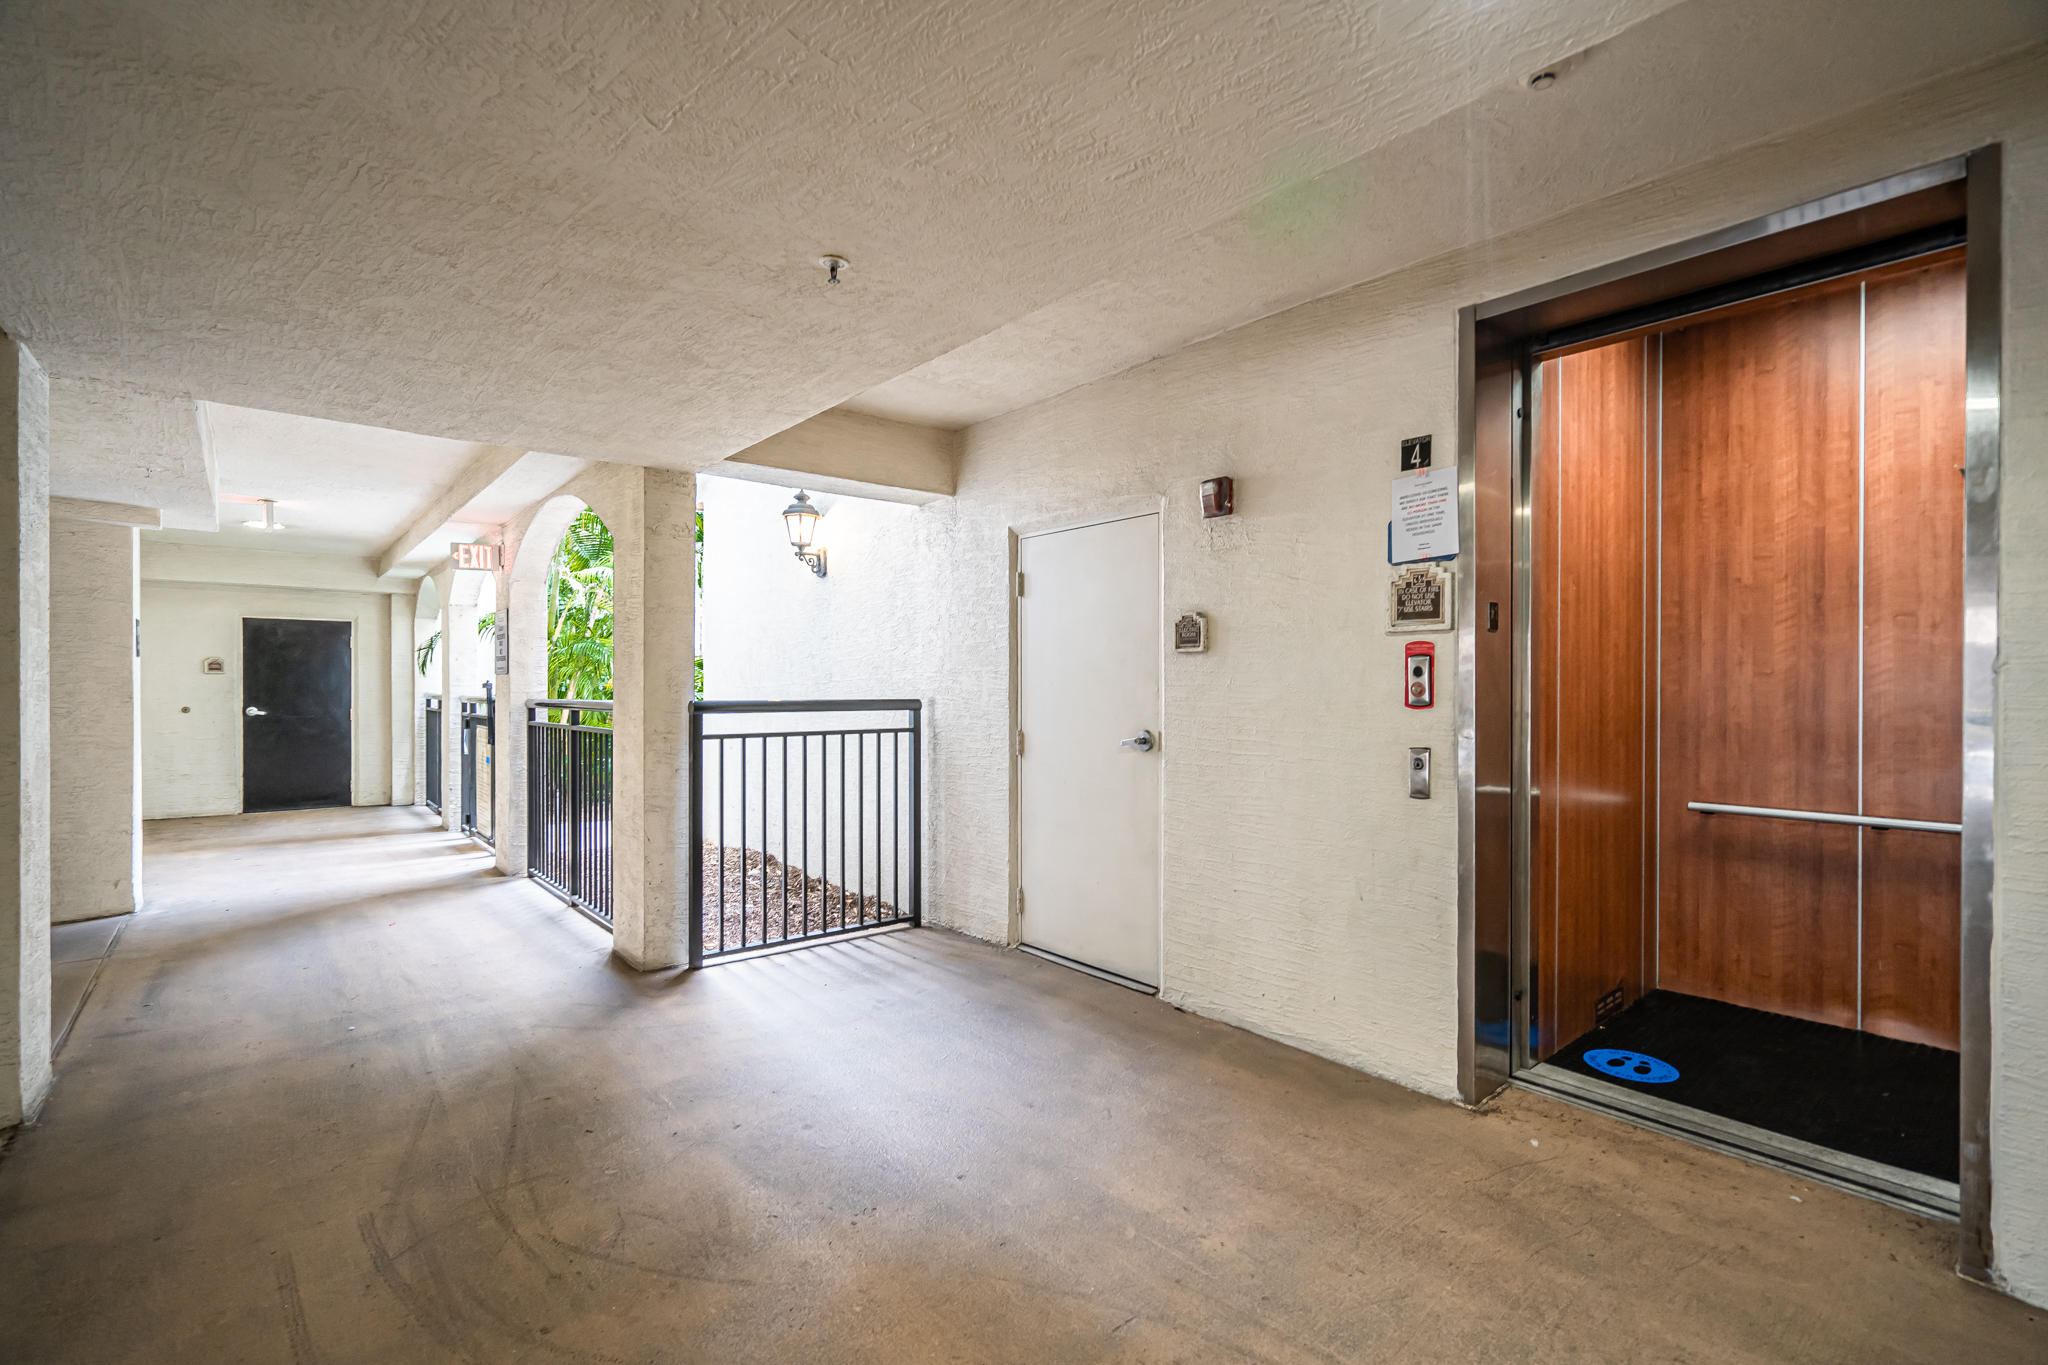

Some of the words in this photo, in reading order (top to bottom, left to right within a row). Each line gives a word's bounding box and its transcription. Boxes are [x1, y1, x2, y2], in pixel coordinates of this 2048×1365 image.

[1402, 436, 1431, 447] ELEVATOR
[1410, 443, 1422, 468] 4
[459, 544, 494, 569] EXIT
[1415, 604, 1433, 612] STAIRS
